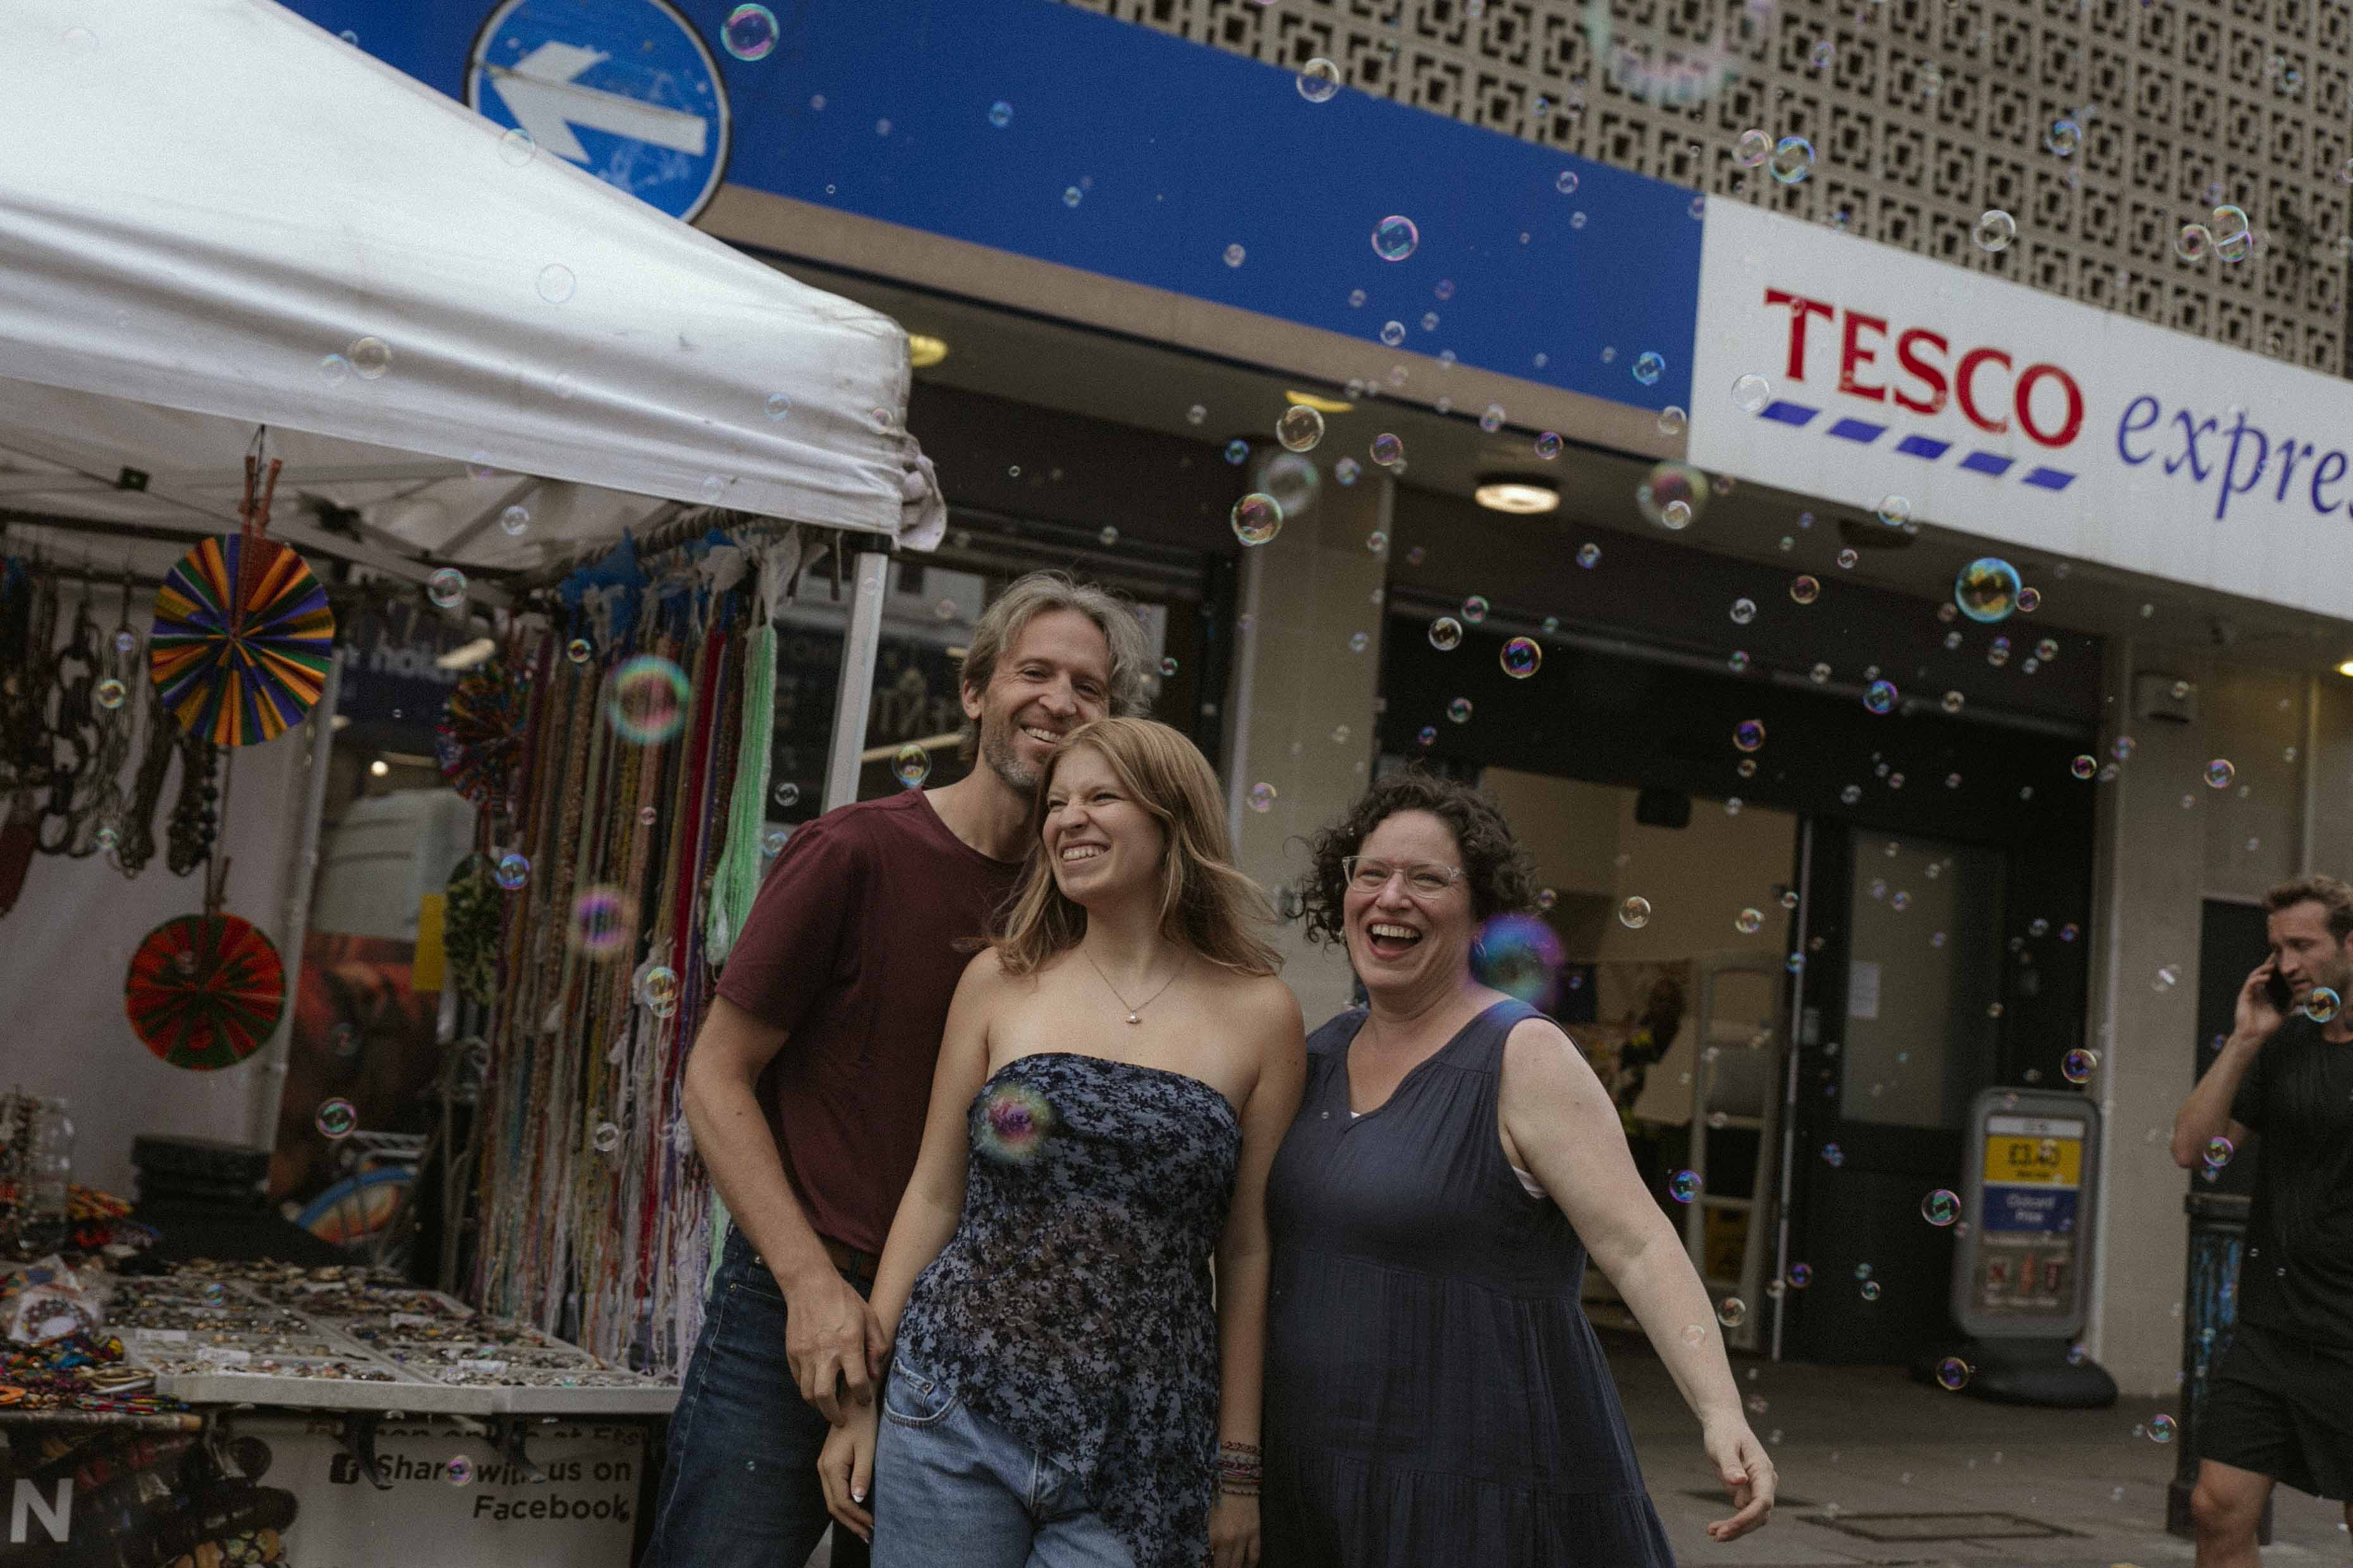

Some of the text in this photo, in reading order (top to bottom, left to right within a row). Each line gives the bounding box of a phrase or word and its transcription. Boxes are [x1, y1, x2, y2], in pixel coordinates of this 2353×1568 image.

[1765, 288, 2353, 521] TESCO expre
[548, 1461, 582, 1481] us
[593, 1461, 631, 1483] on
[9, 1478, 74, 1542] N
